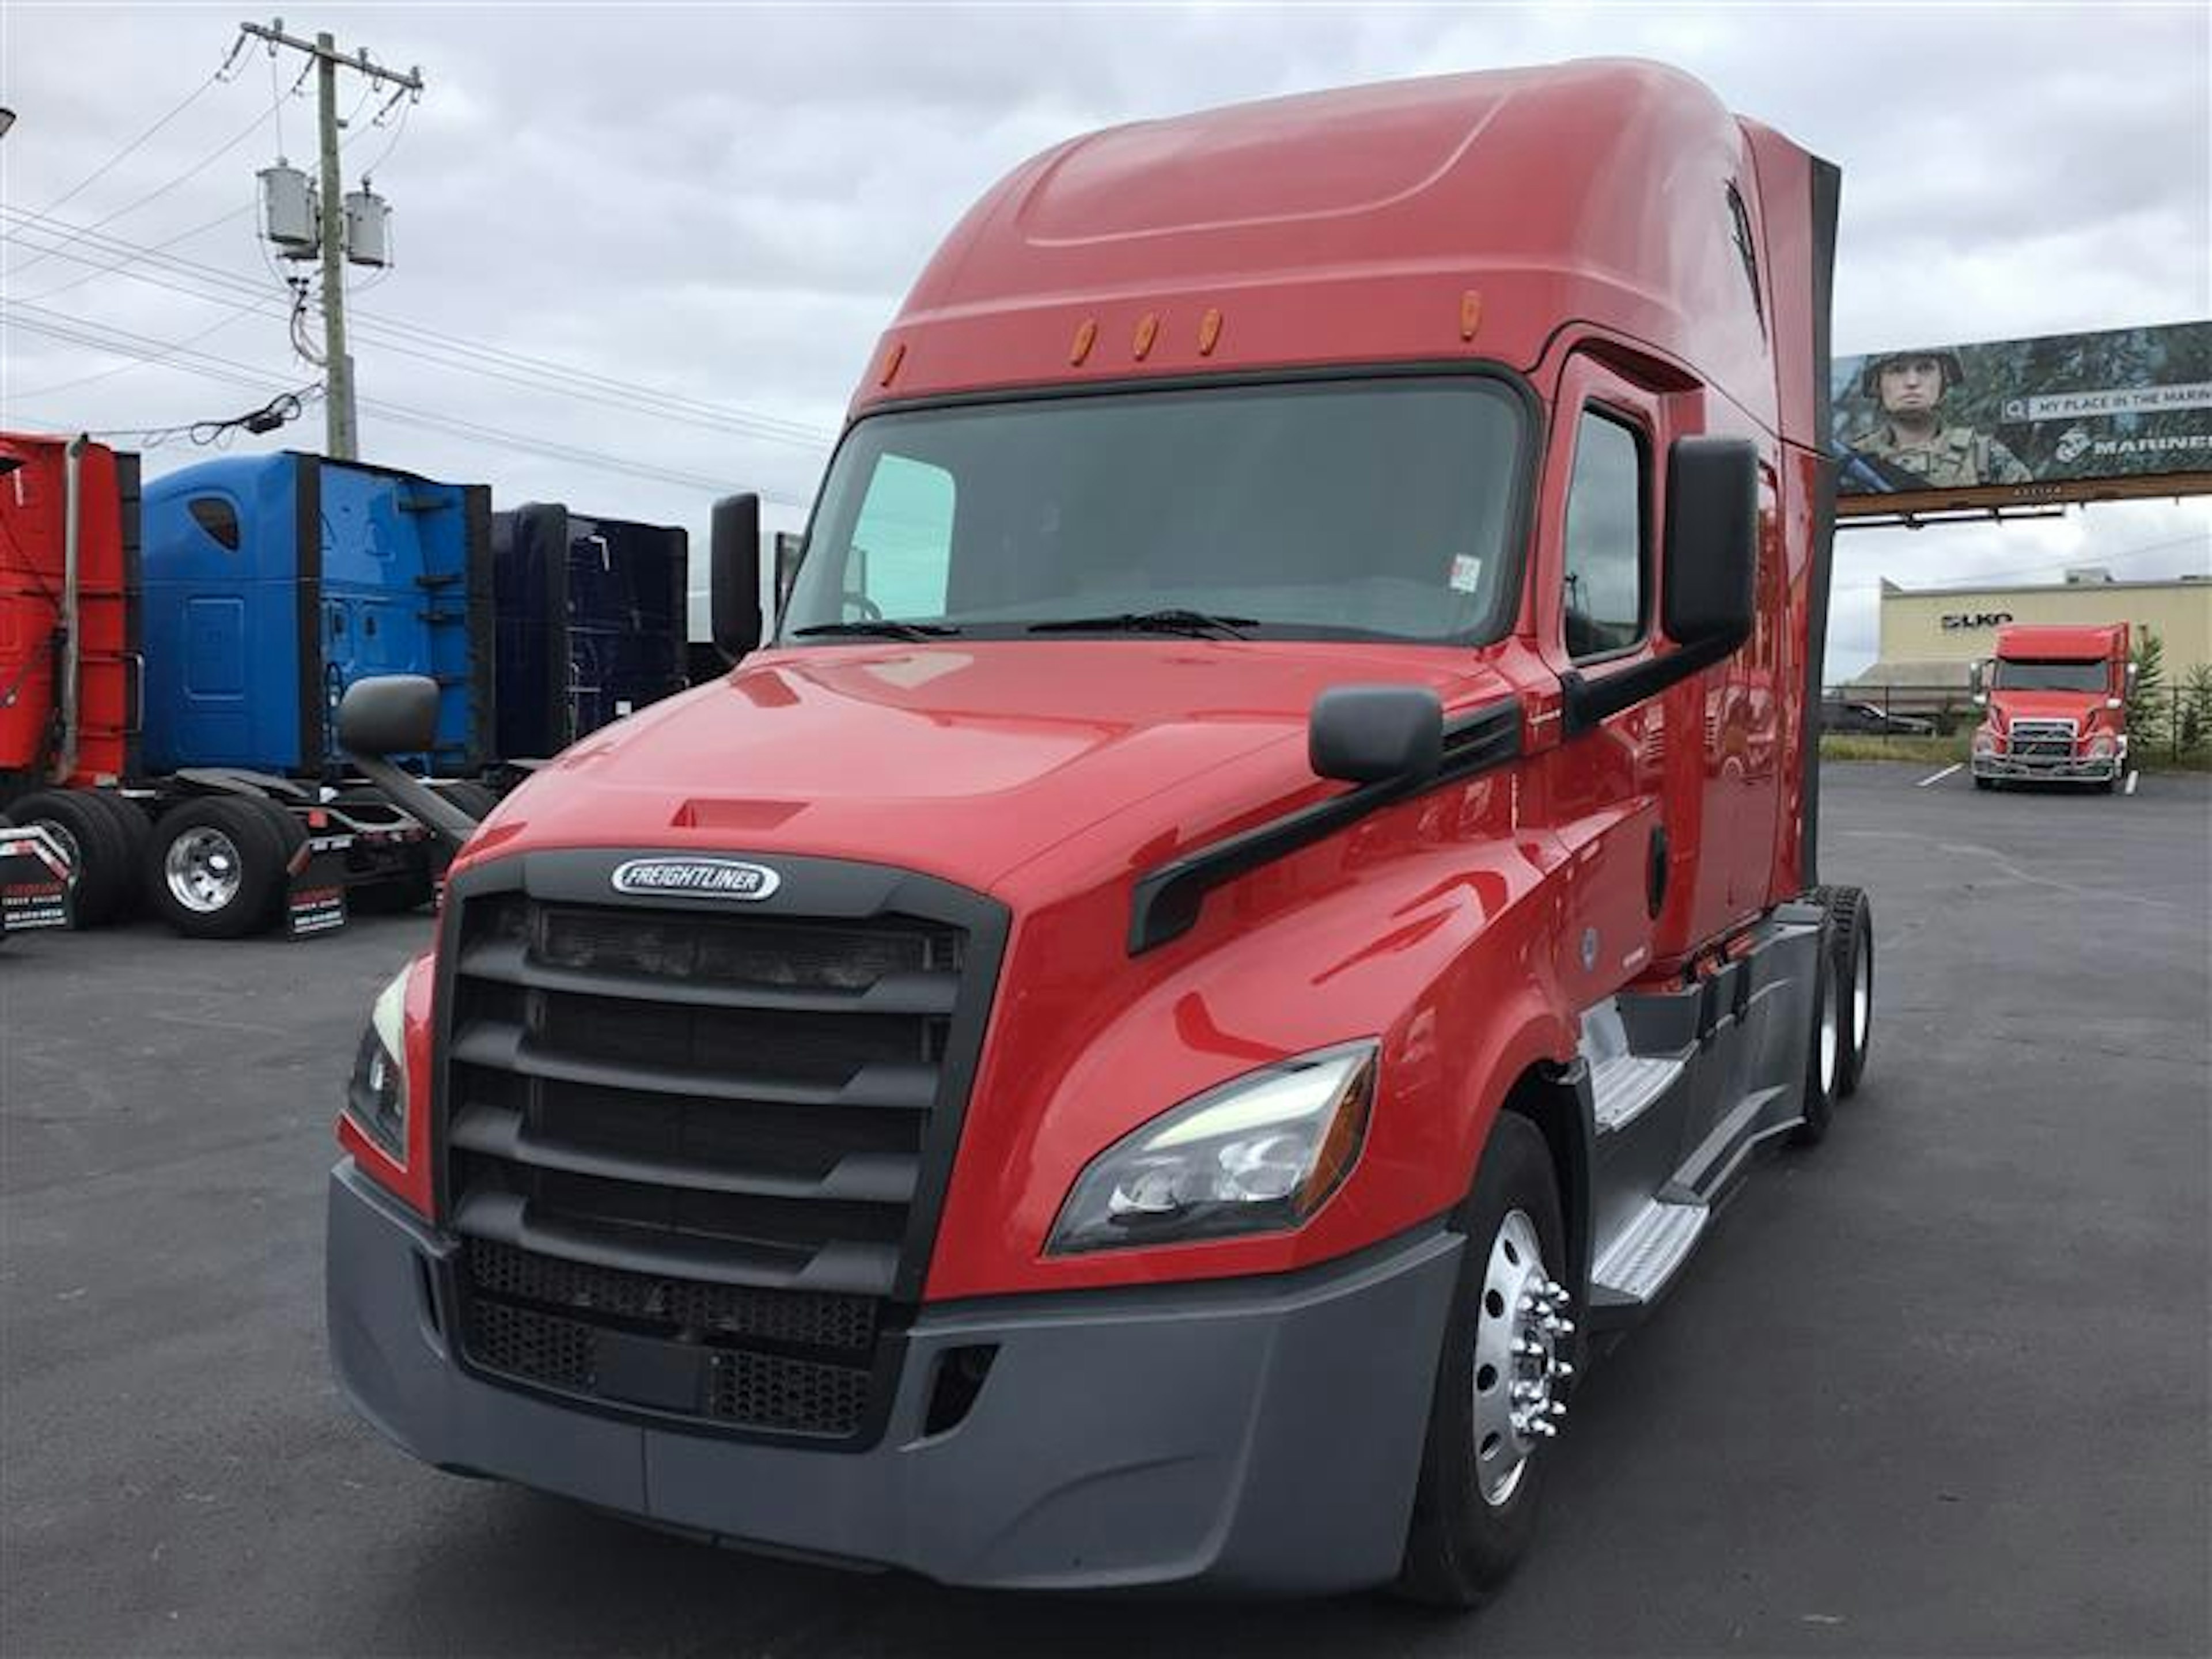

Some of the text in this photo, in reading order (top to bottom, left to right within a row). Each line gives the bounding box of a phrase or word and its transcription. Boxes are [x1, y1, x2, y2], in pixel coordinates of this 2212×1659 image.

[2040, 400, 2059, 411] MY
[2064, 396, 2106, 410] PLACE
[2094, 435, 2212, 456] MARINE
[624, 865, 761, 891] FREIGHTLINER
